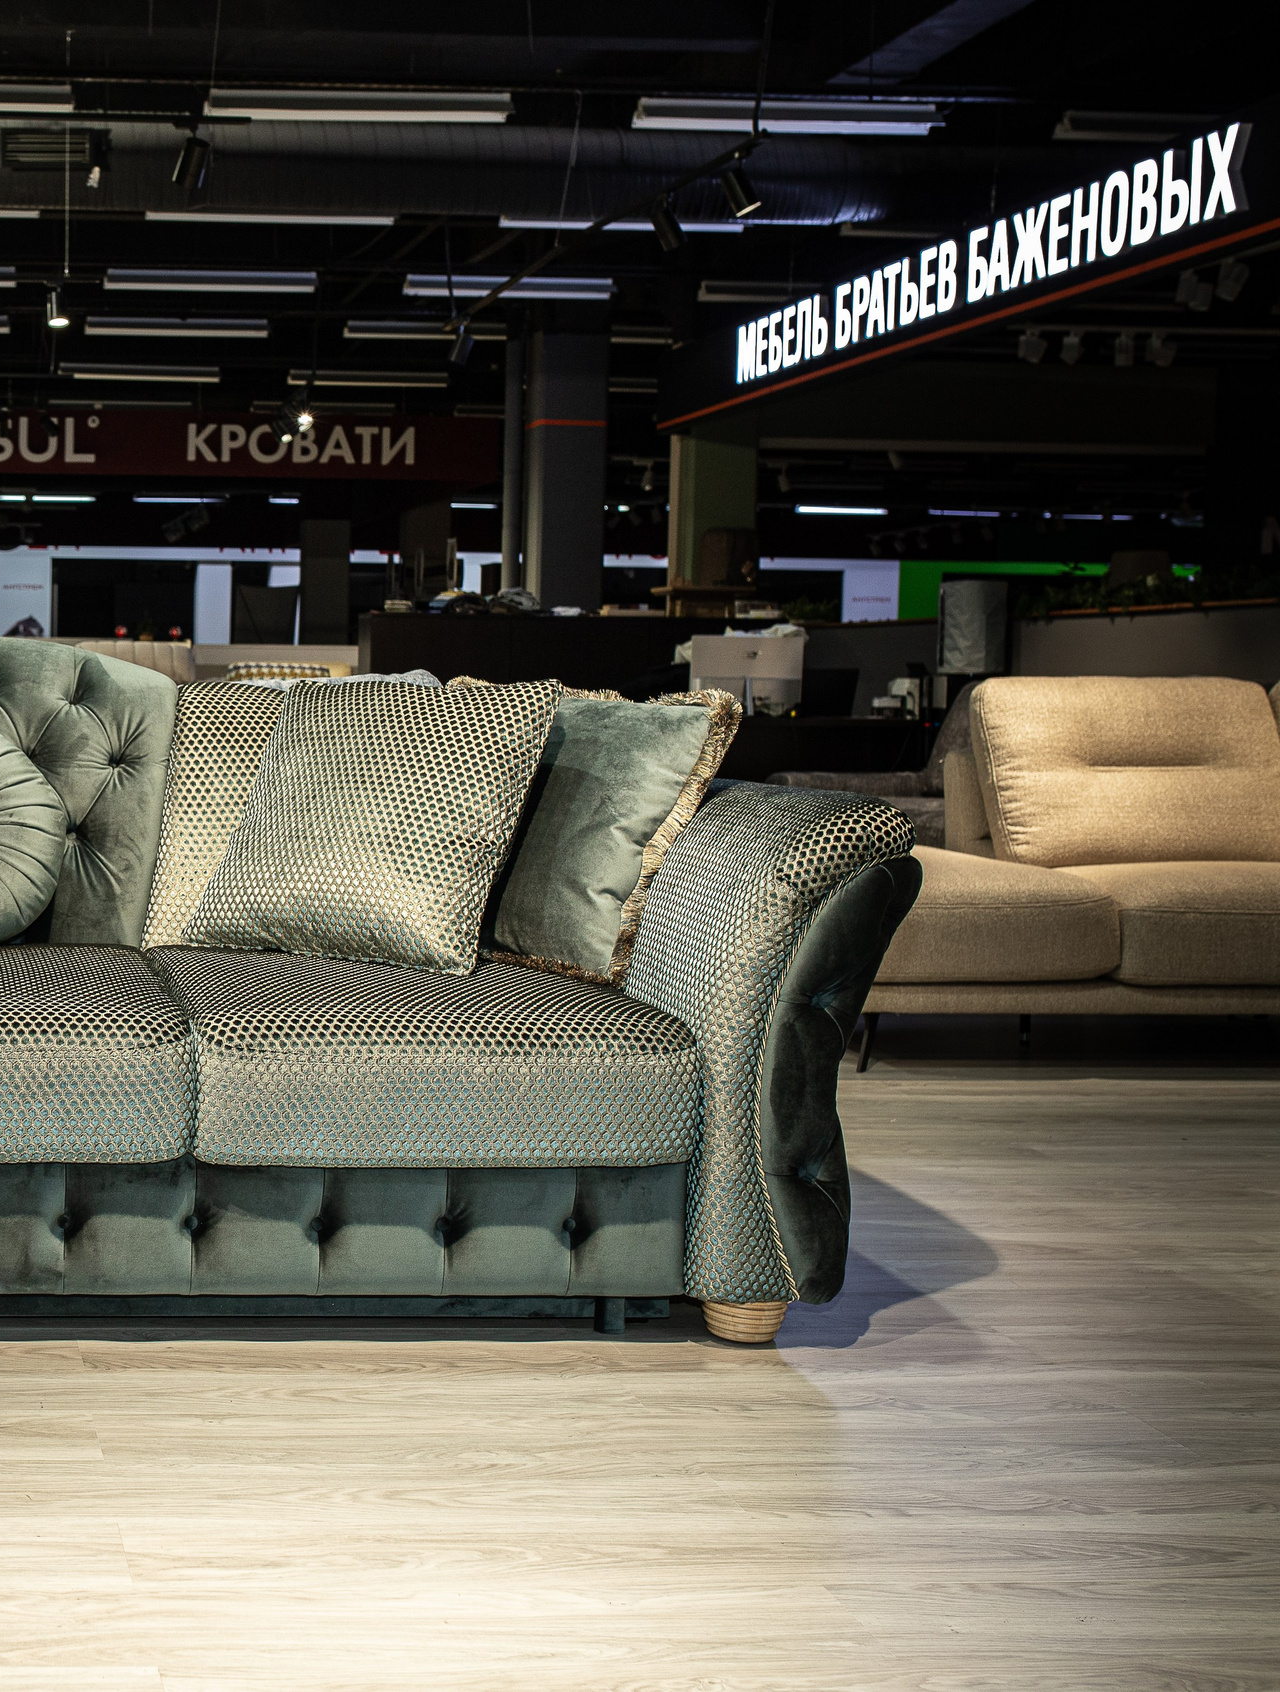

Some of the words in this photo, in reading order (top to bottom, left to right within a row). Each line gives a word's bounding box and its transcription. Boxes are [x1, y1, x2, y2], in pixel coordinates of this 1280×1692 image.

[736, 295, 828, 384] МЕБЕЛЬ
[835, 239, 958, 350] БРАТЬЕВ
[967, 121, 1239, 304] БАЖЕНОВЫХ
[186, 423, 416, 466] КРОВАТИ
